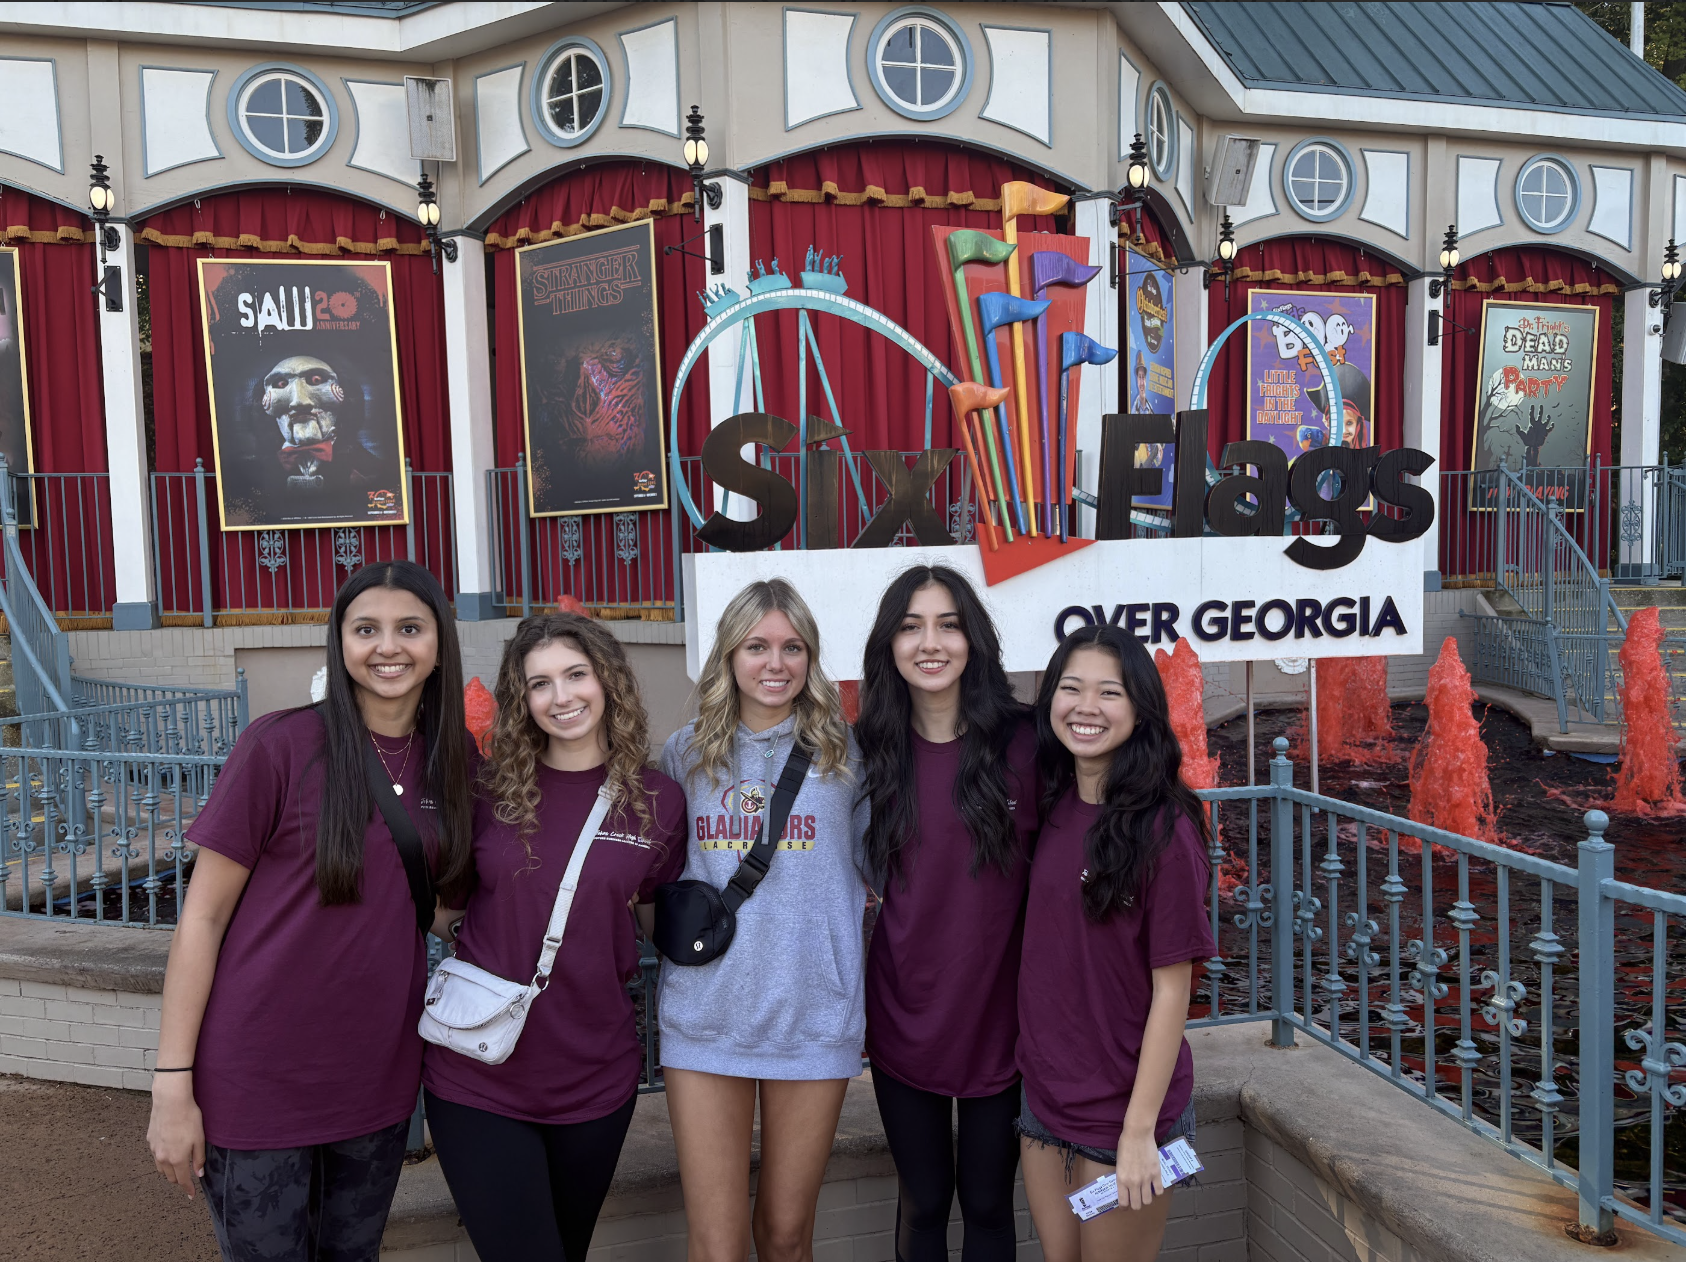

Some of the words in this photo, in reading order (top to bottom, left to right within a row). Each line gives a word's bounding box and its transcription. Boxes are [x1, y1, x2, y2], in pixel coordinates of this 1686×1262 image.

[533, 251, 642, 300] STRANGER
[237, 285, 313, 333] SAW
[550, 280, 623, 316] THINGS
[316, 320, 361, 331] ANNIVERSARY
[1503, 325, 1569, 354] DEAD
[1298, 344, 1347, 372] Fst
[1522, 353, 1573, 373] MAN'S
[1264, 369, 1297, 384] LITTLE
[1502, 365, 1569, 400] PARTY
[1260, 383, 1301, 398] FRIGHTS
[1264, 397, 1276, 411] IN
[1276, 397, 1297, 411] THE
[1257, 410, 1304, 425] DAYLIGHT
[696, 411, 959, 553] Six
[1095, 408, 1437, 570] Flags
[1054, 602, 1182, 645] OVER
[1191, 595, 1408, 643] GEORGIA
[696, 814, 816, 841] GLADIARS
[702, 840, 807, 850] LACRSE
